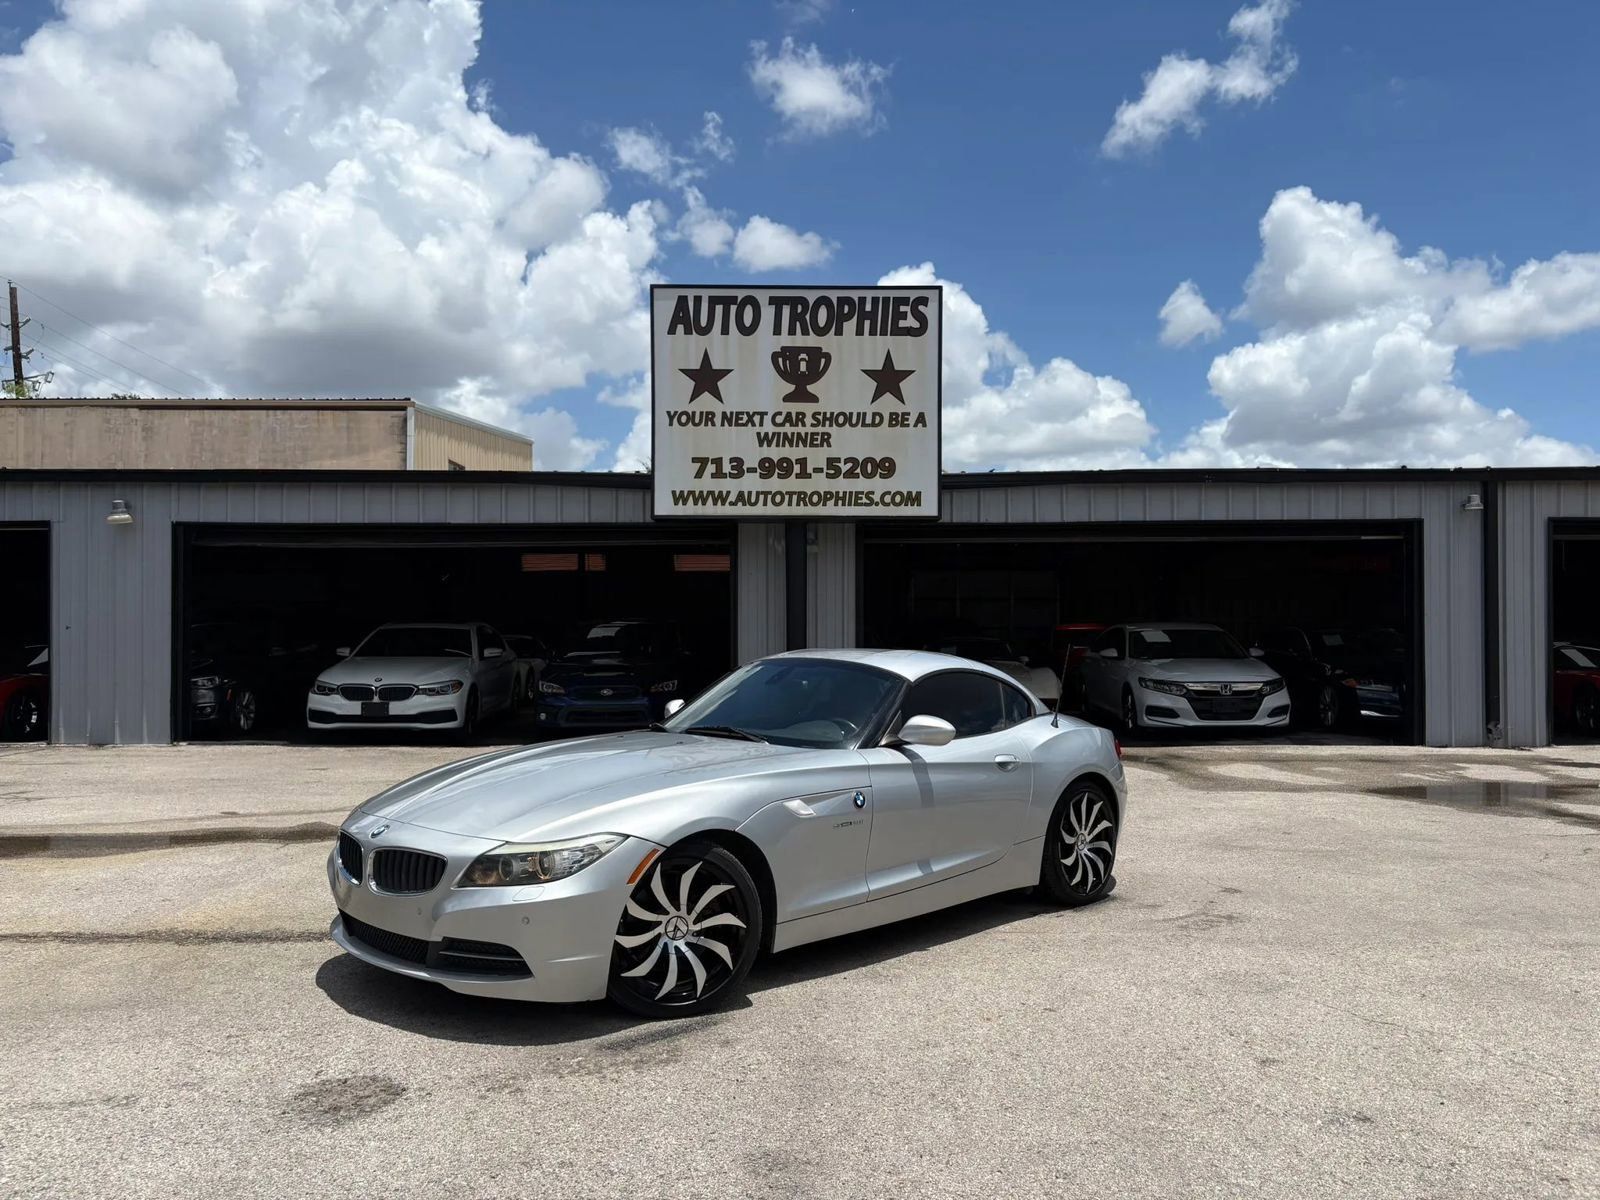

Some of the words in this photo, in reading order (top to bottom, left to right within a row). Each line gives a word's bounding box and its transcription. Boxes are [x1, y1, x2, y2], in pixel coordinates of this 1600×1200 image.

[666, 294, 762, 337] AUTO
[768, 295, 930, 338] TROPHIES
[666, 410, 716, 427] YOUR
[720, 411, 768, 428] NEXT
[771, 411, 806, 428] CAR
[810, 411, 884, 428] SHOULD
[888, 412, 911, 428] BE
[913, 412, 927, 428] A
[756, 431, 832, 448] WINNER
[691, 456, 897, 480] 713-991-5209
[671, 490, 922, 507] WWW.AUTOTROPHIES.COM
